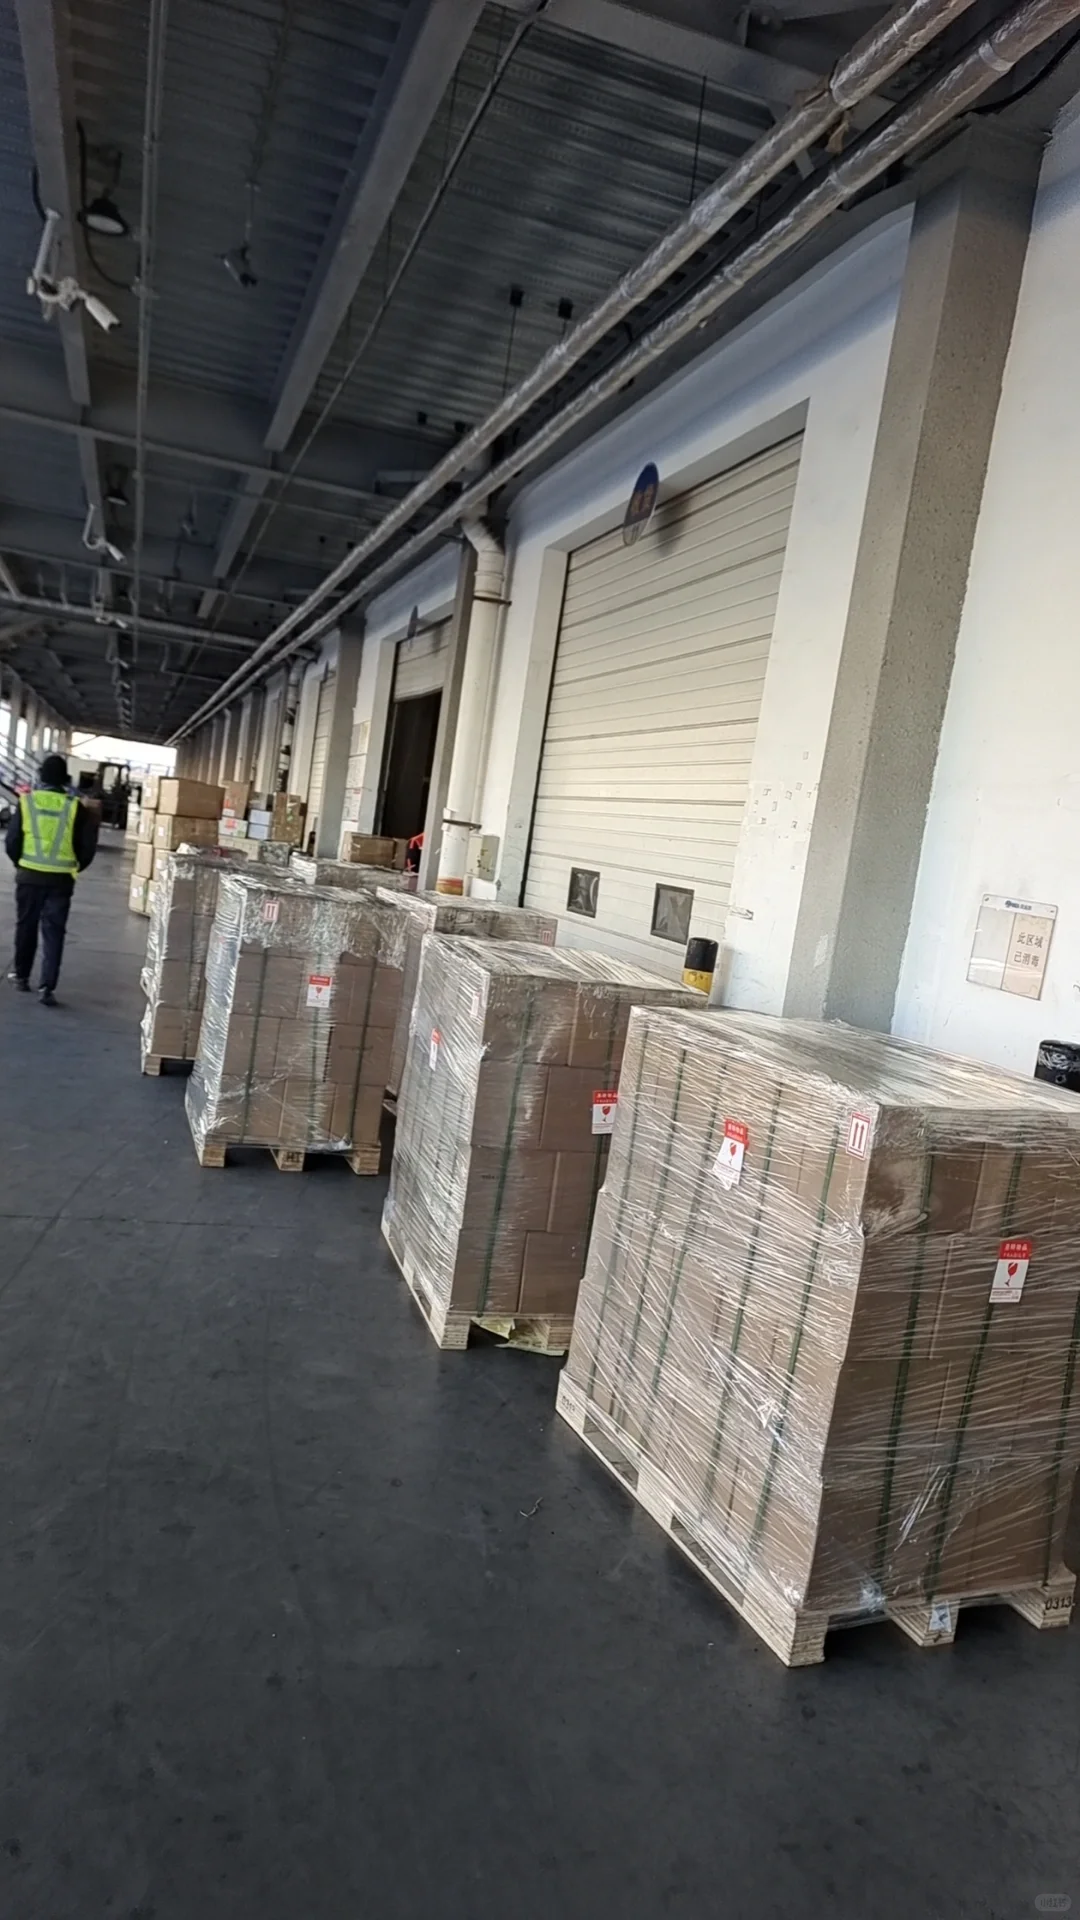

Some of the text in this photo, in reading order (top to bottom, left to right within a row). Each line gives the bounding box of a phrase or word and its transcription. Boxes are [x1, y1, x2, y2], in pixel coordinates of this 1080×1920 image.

[1016, 931, 1044, 949] 此区域
[1045, 1595, 1072, 1610] 0313
